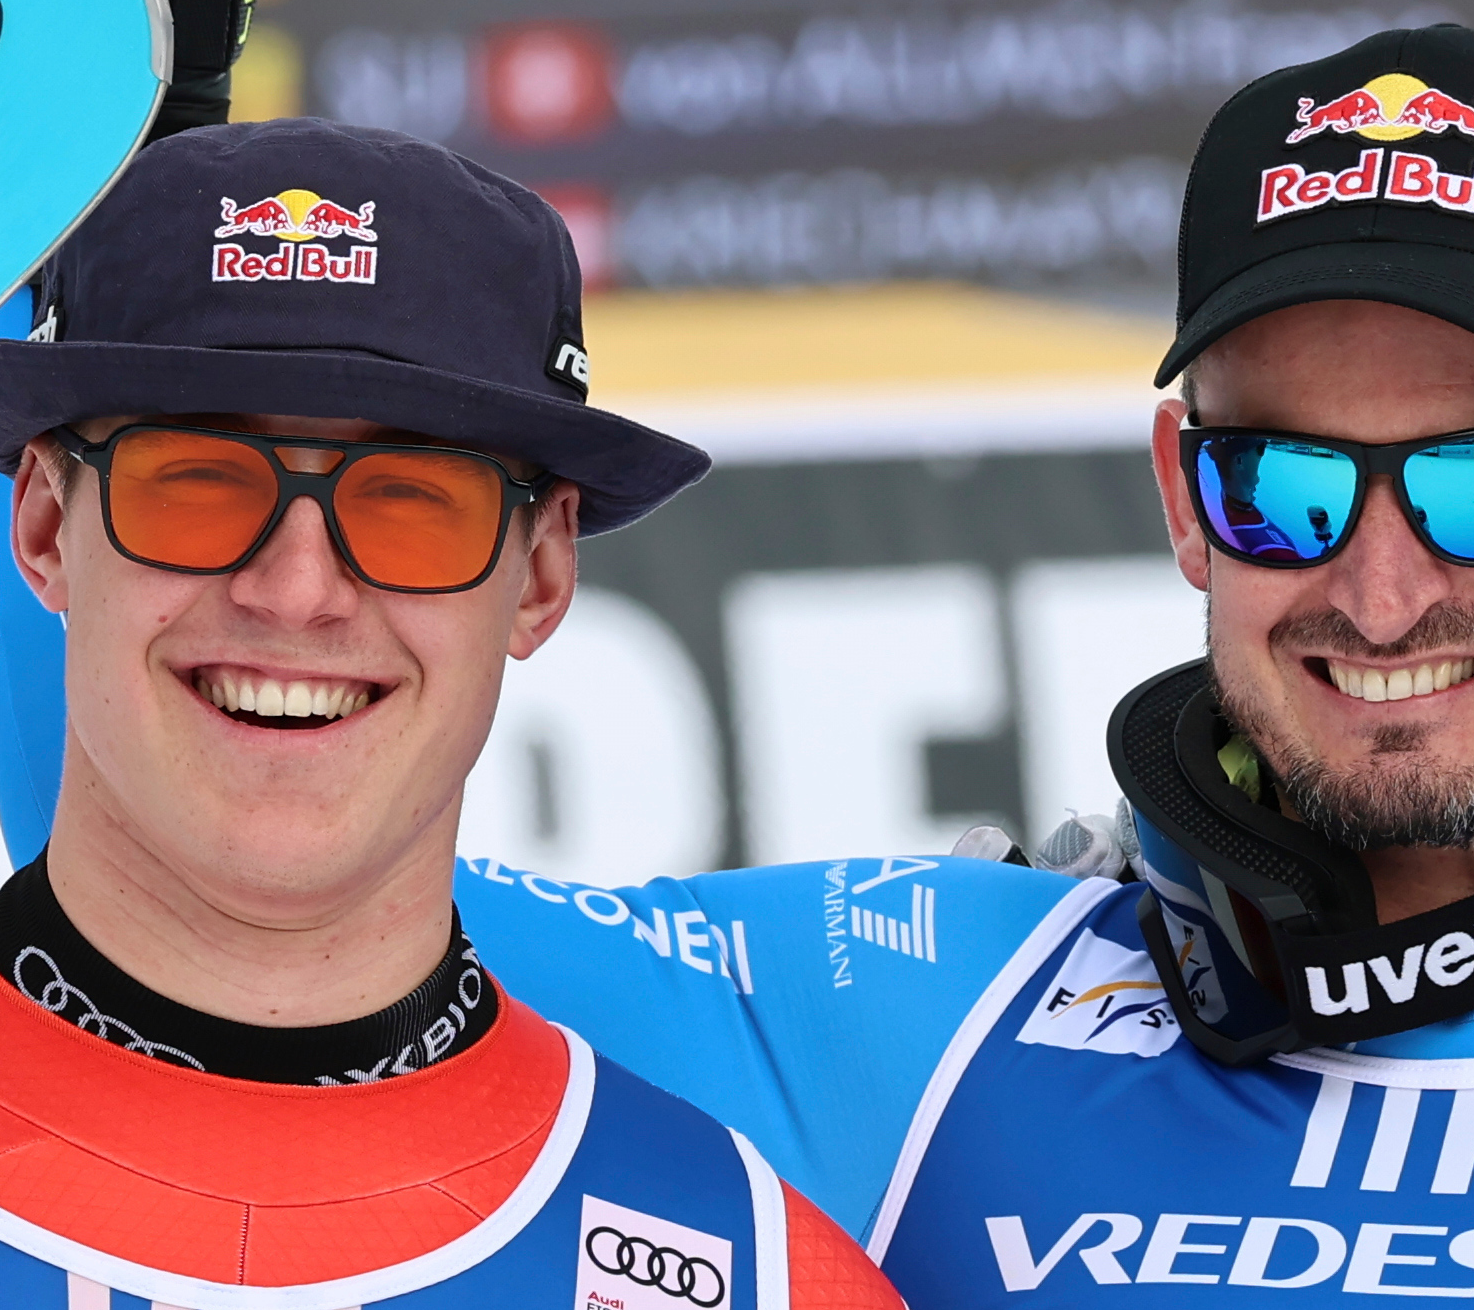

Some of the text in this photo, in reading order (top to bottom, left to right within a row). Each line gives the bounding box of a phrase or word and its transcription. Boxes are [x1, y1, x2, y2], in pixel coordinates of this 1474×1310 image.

[1257, 149, 1383, 222] Red
[214, 244, 376, 283] Red Bull
[824, 886, 854, 990] ARMANI
[1047, 986, 1175, 1029] FIS
[587, 1290, 624, 1310] Audi
